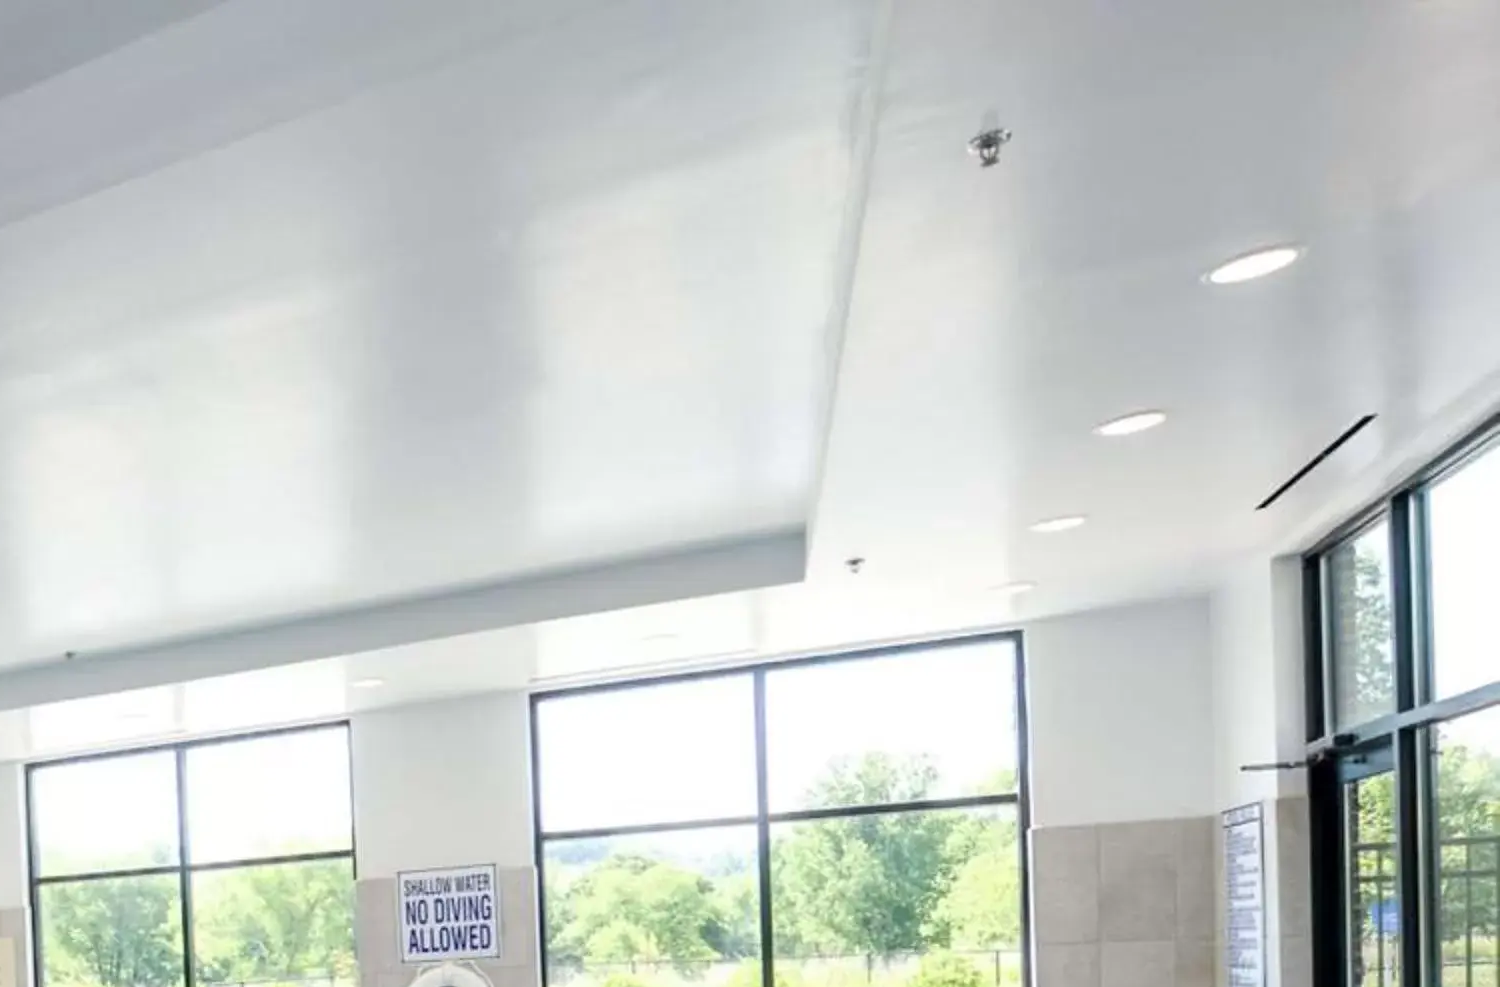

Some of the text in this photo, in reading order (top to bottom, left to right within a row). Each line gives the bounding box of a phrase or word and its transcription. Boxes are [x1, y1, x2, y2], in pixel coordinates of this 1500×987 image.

[404, 873, 491, 897] SHALLOW WATER
[405, 894, 493, 925] NO DIVING
[409, 923, 491, 954] ALLOWED
